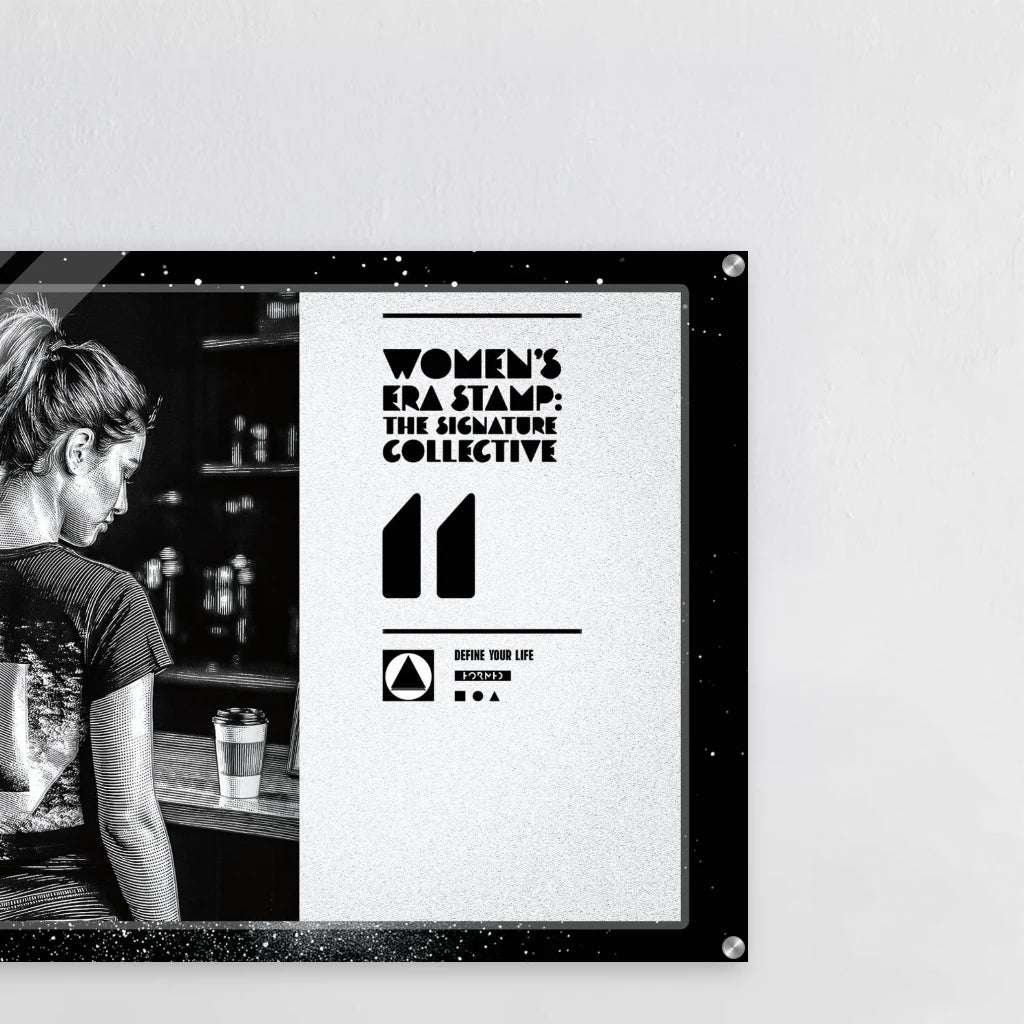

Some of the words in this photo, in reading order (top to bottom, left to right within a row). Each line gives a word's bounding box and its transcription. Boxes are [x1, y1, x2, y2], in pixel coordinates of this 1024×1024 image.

[382, 348, 562, 380] WOMEN'S
[382, 384, 444, 412] ERA
[450, 384, 563, 412] STAMP:
[382, 416, 429, 435] THE
[435, 416, 558, 435] SIGNATURE
[382, 439, 558, 464] COLLECTIVE
[454, 649, 485, 661] DEFINE
[489, 649, 512, 661] YOUR
[515, 649, 534, 661] LIFE
